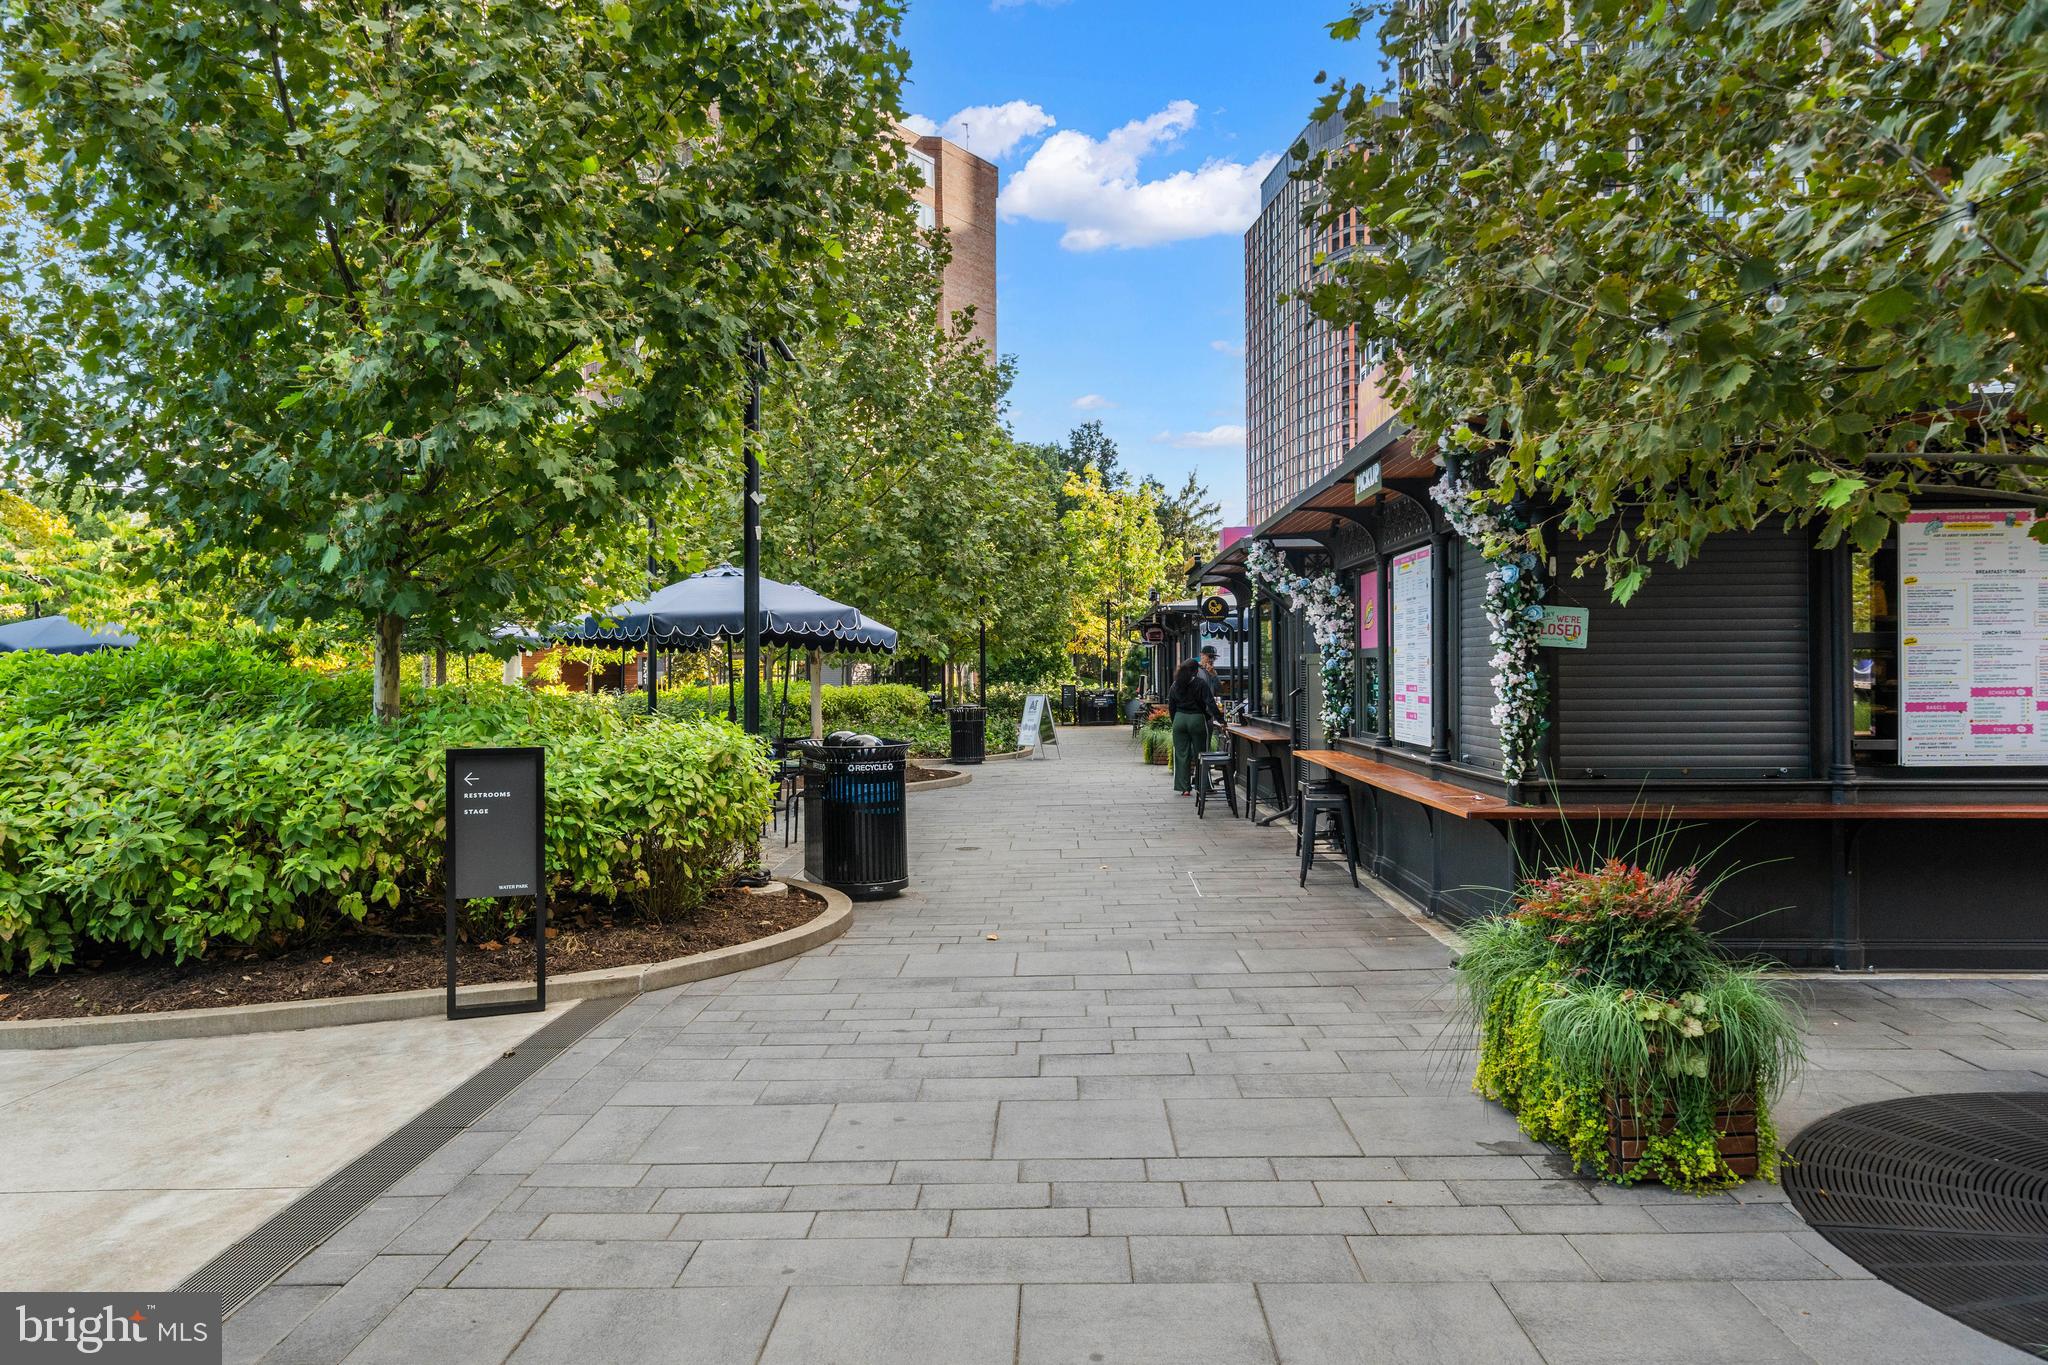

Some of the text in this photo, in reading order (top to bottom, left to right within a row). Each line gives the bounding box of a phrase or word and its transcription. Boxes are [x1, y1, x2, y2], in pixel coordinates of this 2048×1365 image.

[1356, 462, 1380, 494] PICKUP
[1557, 615, 1582, 623] WE'RE
[1540, 623, 1582, 637] LOSED
[855, 763, 888, 771] RECYCLE
[463, 791, 511, 799] RESTROOMS
